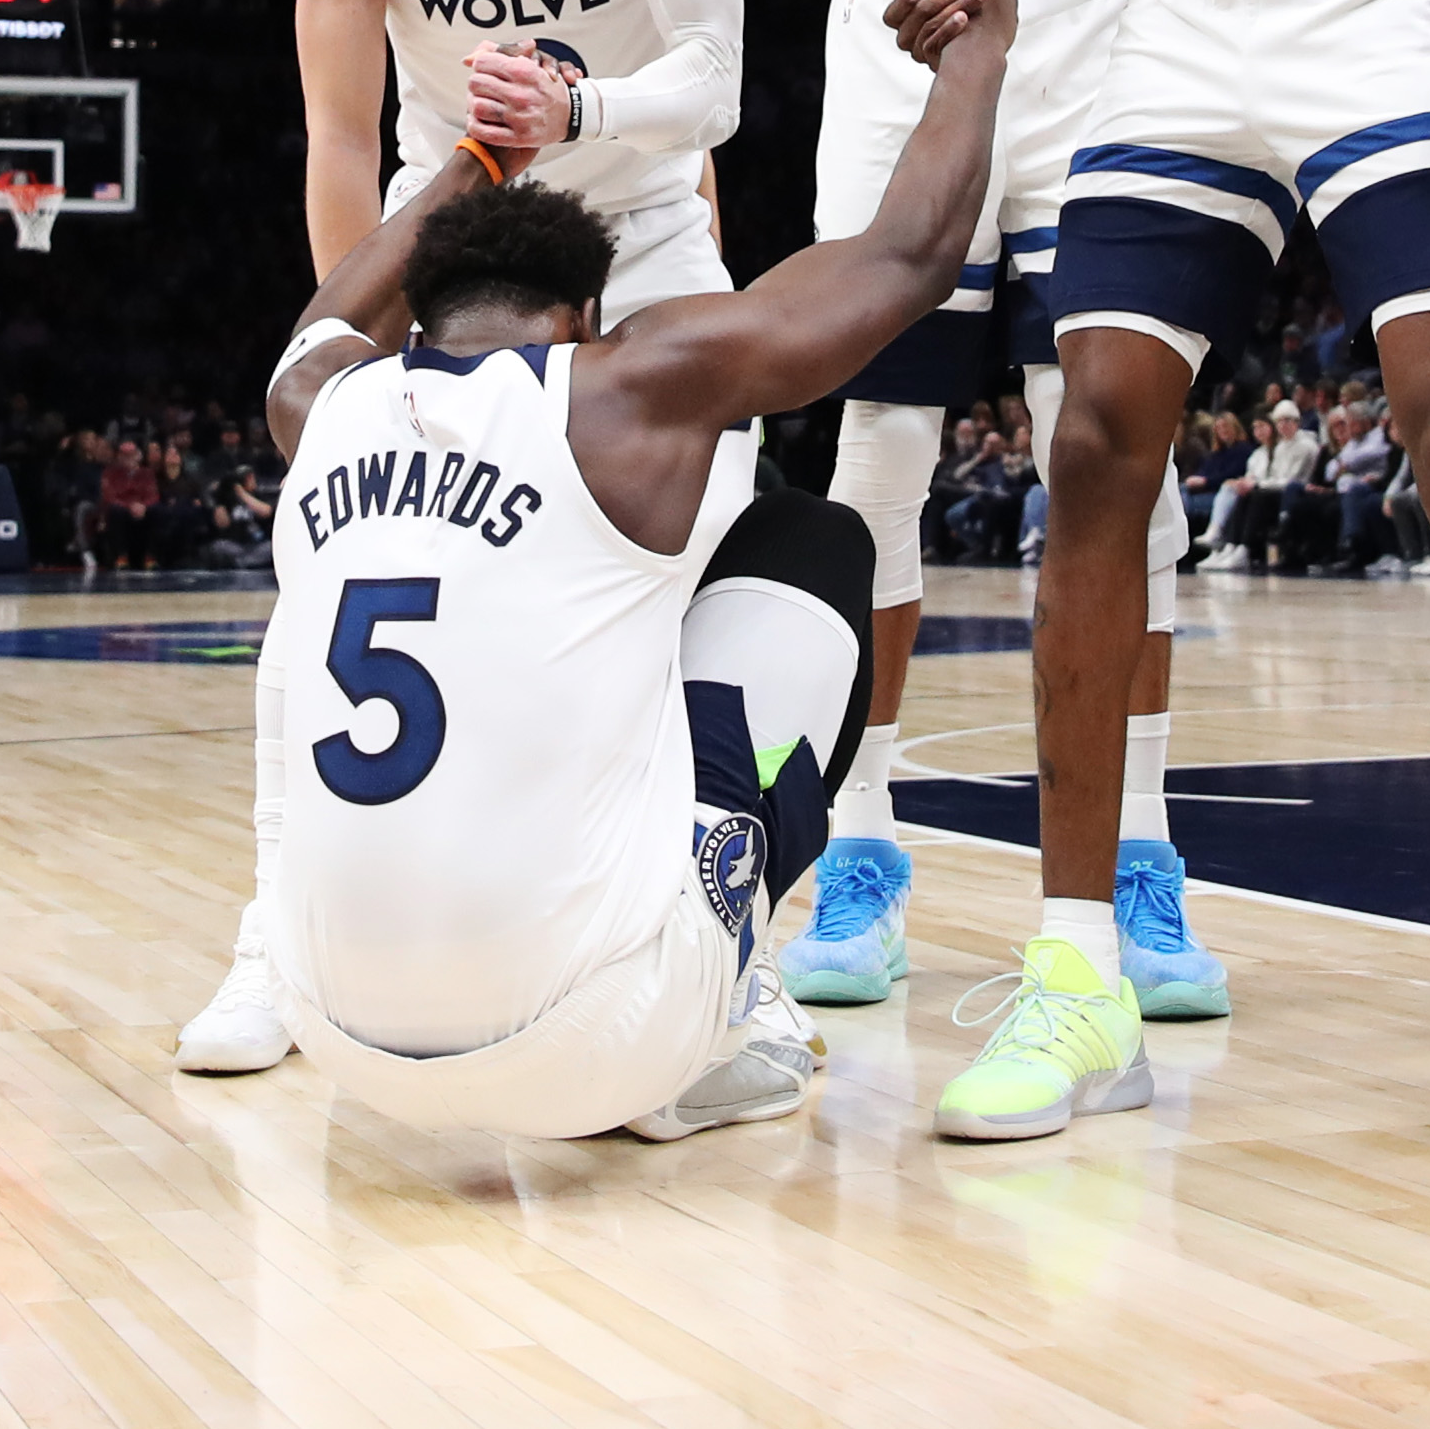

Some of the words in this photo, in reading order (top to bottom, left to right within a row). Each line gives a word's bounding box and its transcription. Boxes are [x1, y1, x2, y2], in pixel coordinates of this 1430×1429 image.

[570, 87, 581, 127] Believe
[298, 450, 543, 553] EDWARDS
[312, 577, 447, 806] 5
[701, 819, 740, 919] TIMBERWOLVES
